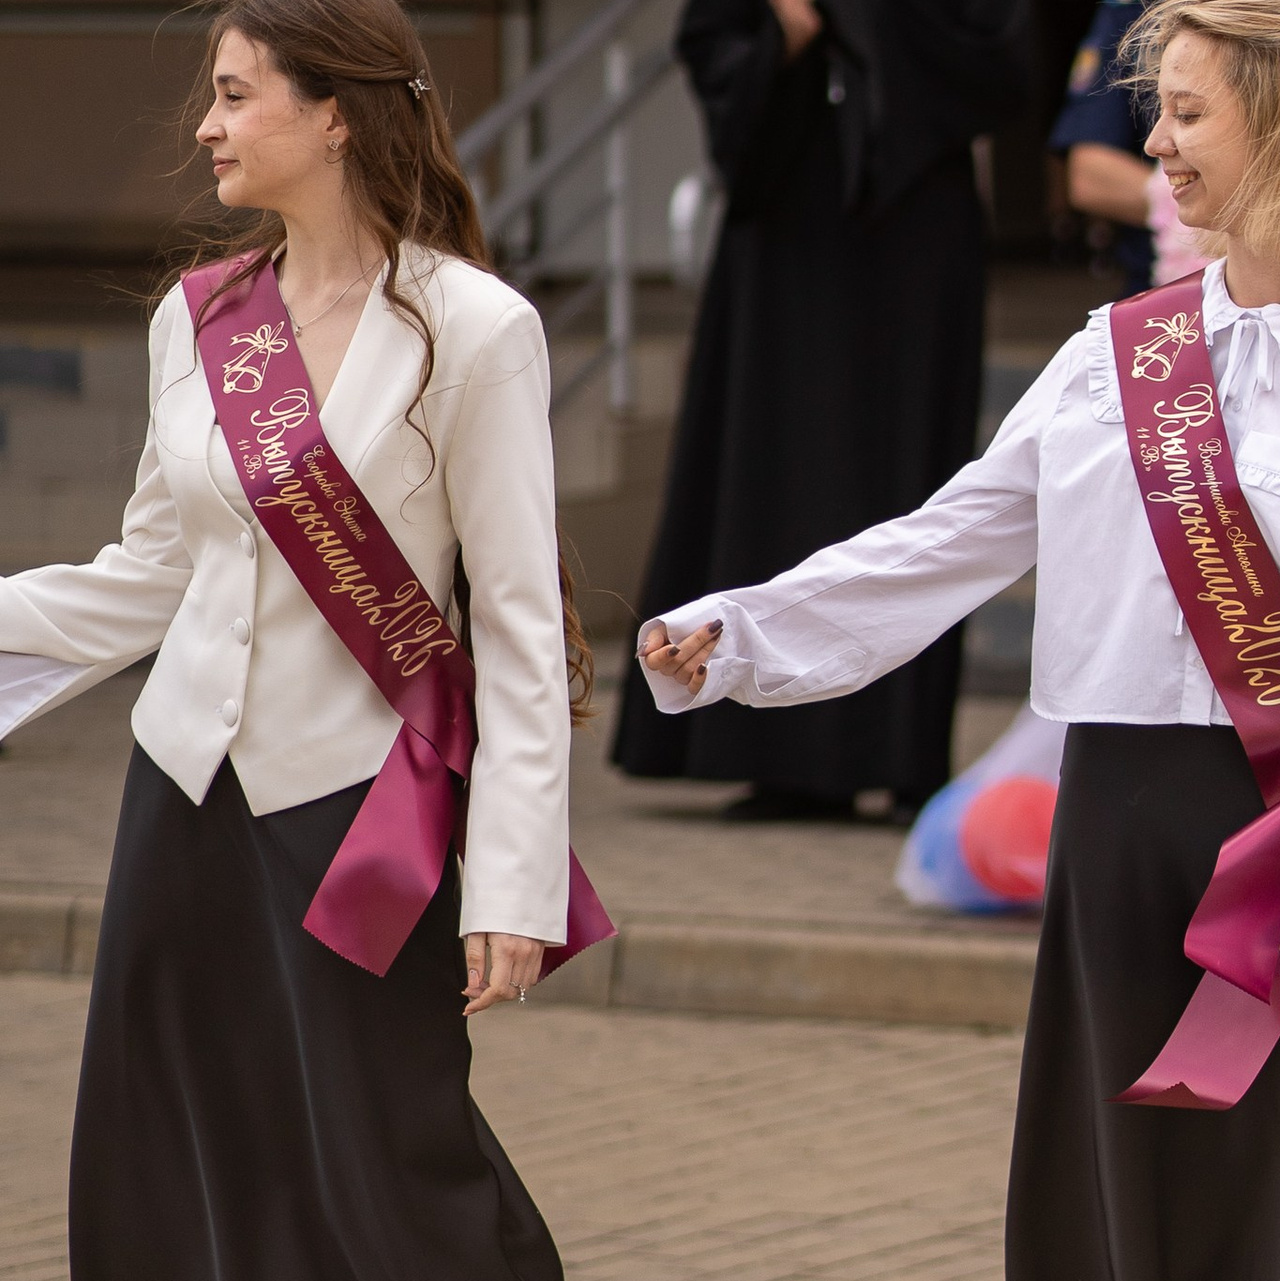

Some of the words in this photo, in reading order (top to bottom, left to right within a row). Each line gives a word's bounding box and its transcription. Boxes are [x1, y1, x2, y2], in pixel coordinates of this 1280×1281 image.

[237, 439, 252, 451] 11
[302, 444, 342, 500] Егорова
[1136, 426, 1151, 439] 11
[250, 387, 381, 608] Выпускница
[360, 579, 457, 677] 2026
[1146, 383, 1248, 622] Выпускница
[1197, 437, 1239, 526] Вострикова
[1226, 526, 1265, 598] Ангелина
